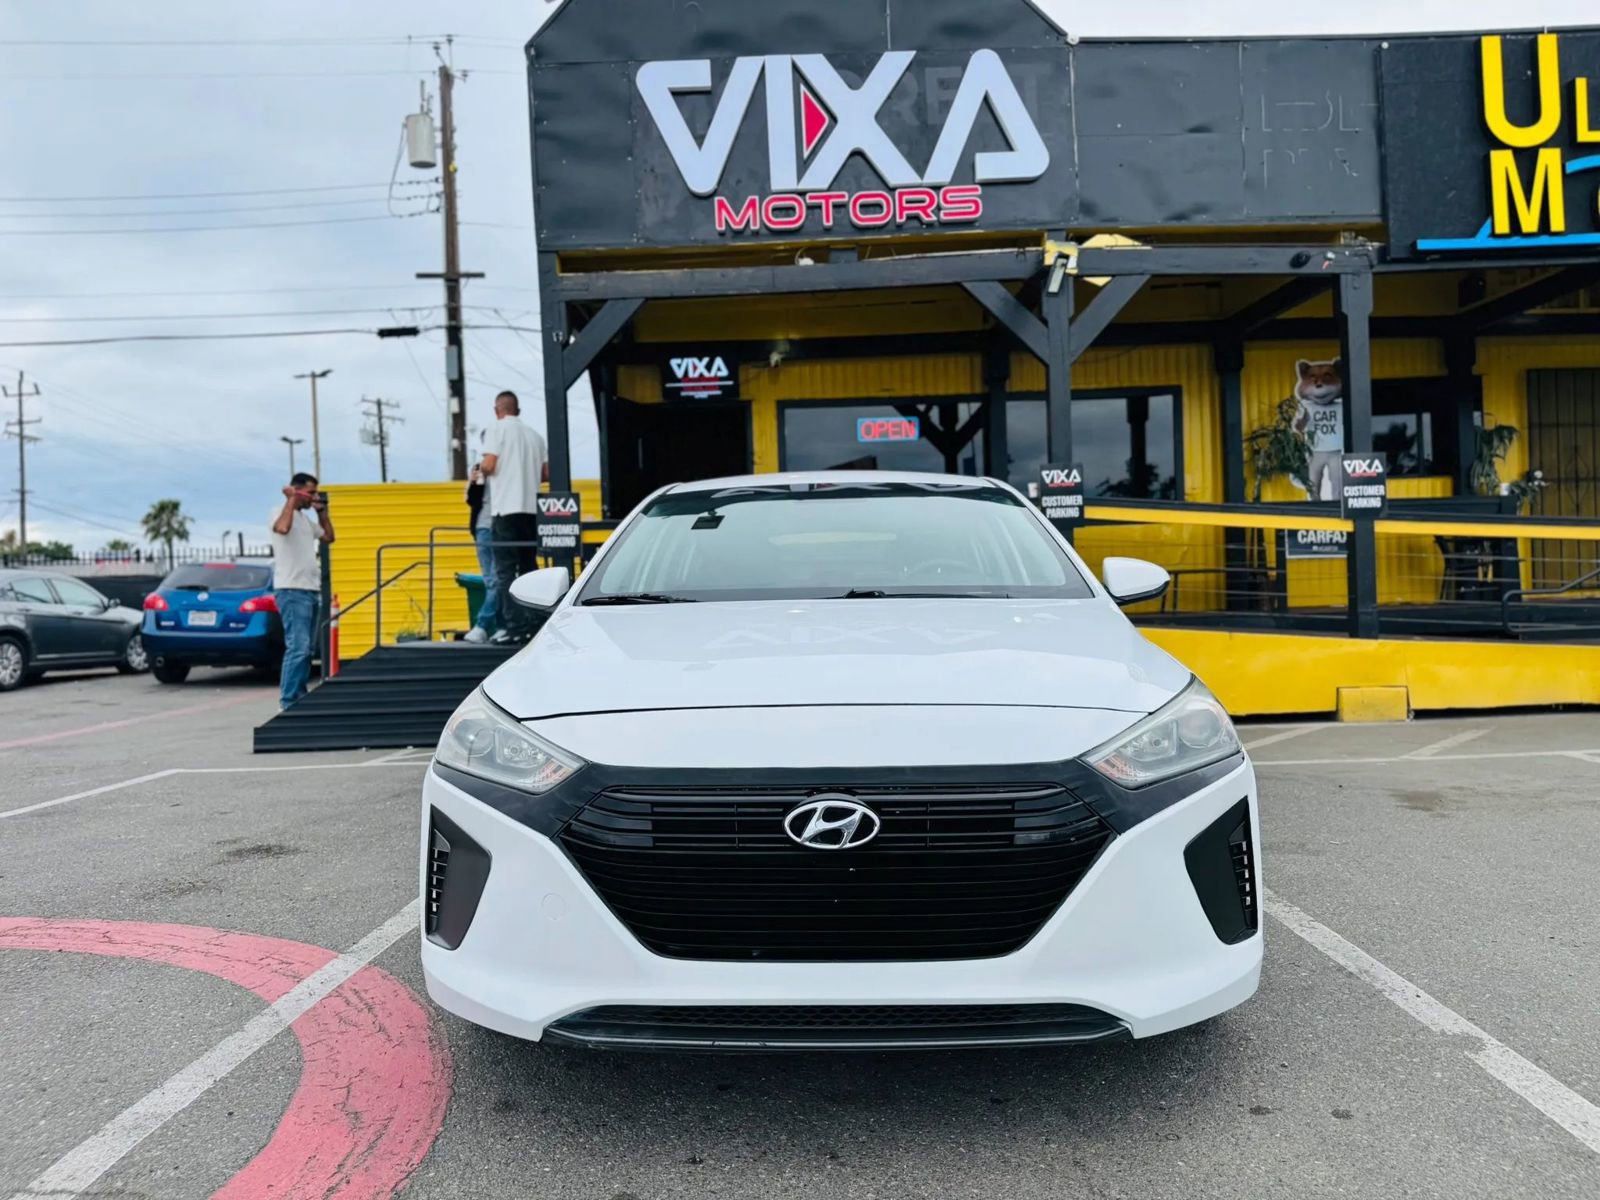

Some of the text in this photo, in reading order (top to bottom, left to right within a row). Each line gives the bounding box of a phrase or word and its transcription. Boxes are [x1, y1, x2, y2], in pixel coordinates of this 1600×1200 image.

[636, 48, 1050, 196] VIXA
[1490, 147, 1600, 235] M
[714, 185, 983, 231] MOTORS
[669, 356, 729, 379] VIXA
[1313, 410, 1338, 422] CAR
[860, 420, 917, 440] OPEN
[1314, 423, 1337, 436] FOX
[1343, 458, 1384, 474] VIXA
[1041, 468, 1082, 484] VIXA
[1343, 484, 1385, 497] CUSTOMER
[537, 497, 578, 512] VIXA
[1041, 494, 1083, 507] CUSTOMER
[1347, 497, 1382, 509] PARKING
[1045, 506, 1080, 519] PARKING
[537, 524, 579, 536] CUSTOMER
[541, 536, 576, 548] PARKING
